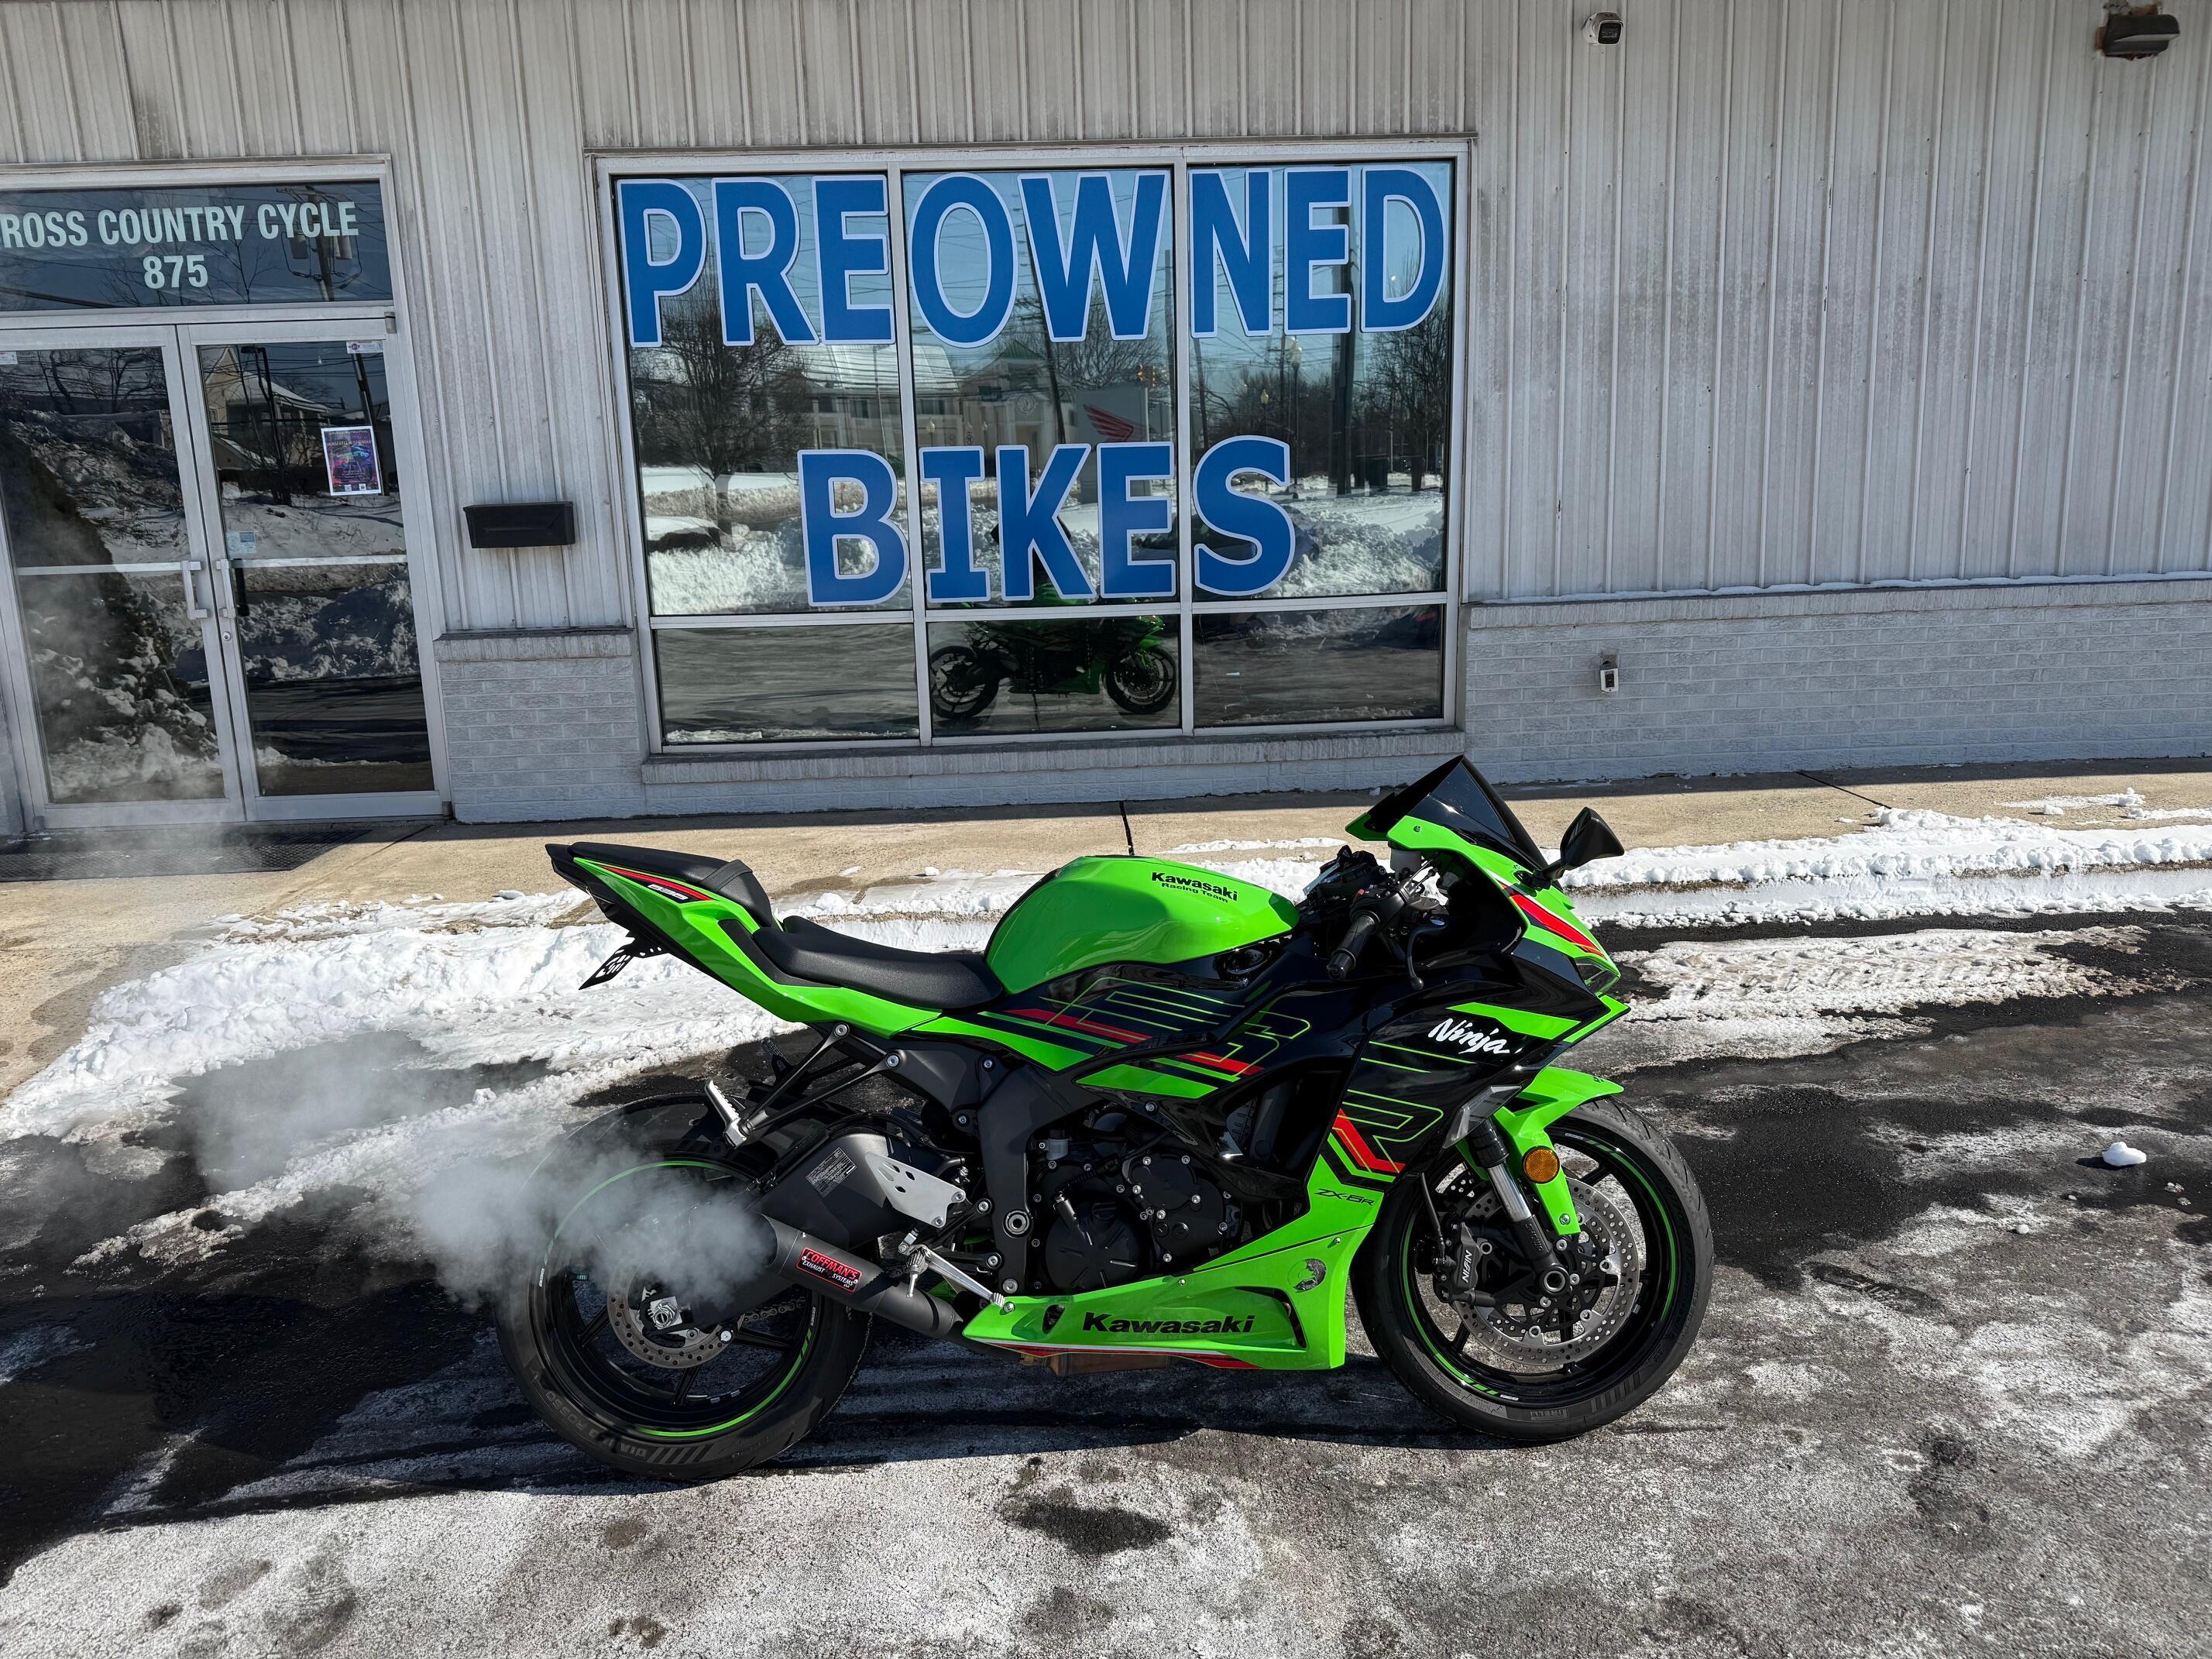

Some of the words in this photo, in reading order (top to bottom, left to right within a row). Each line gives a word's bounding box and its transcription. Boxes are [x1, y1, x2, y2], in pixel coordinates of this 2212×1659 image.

[98, 204, 245, 245] COUNTRY
[257, 201, 359, 240] CYCLE
[143, 254, 208, 289] 875
[617, 165, 1449, 348] PREOWNED
[798, 435, 1296, 606] BIKES
[1152, 872, 1238, 902] Kawasaki
[1161, 882, 1199, 894] Racing
[1201, 889, 1228, 903] Team
[1427, 1018, 1510, 1054] Ninja
[1314, 1188, 1375, 1207] ZX-6R
[802, 1260, 826, 1273] EXHAUST
[831, 1273, 854, 1286] SYSTEMS
[805, 1252, 858, 1279] COFFMAN'S
[1082, 1311, 1255, 1334] Kawasaki
